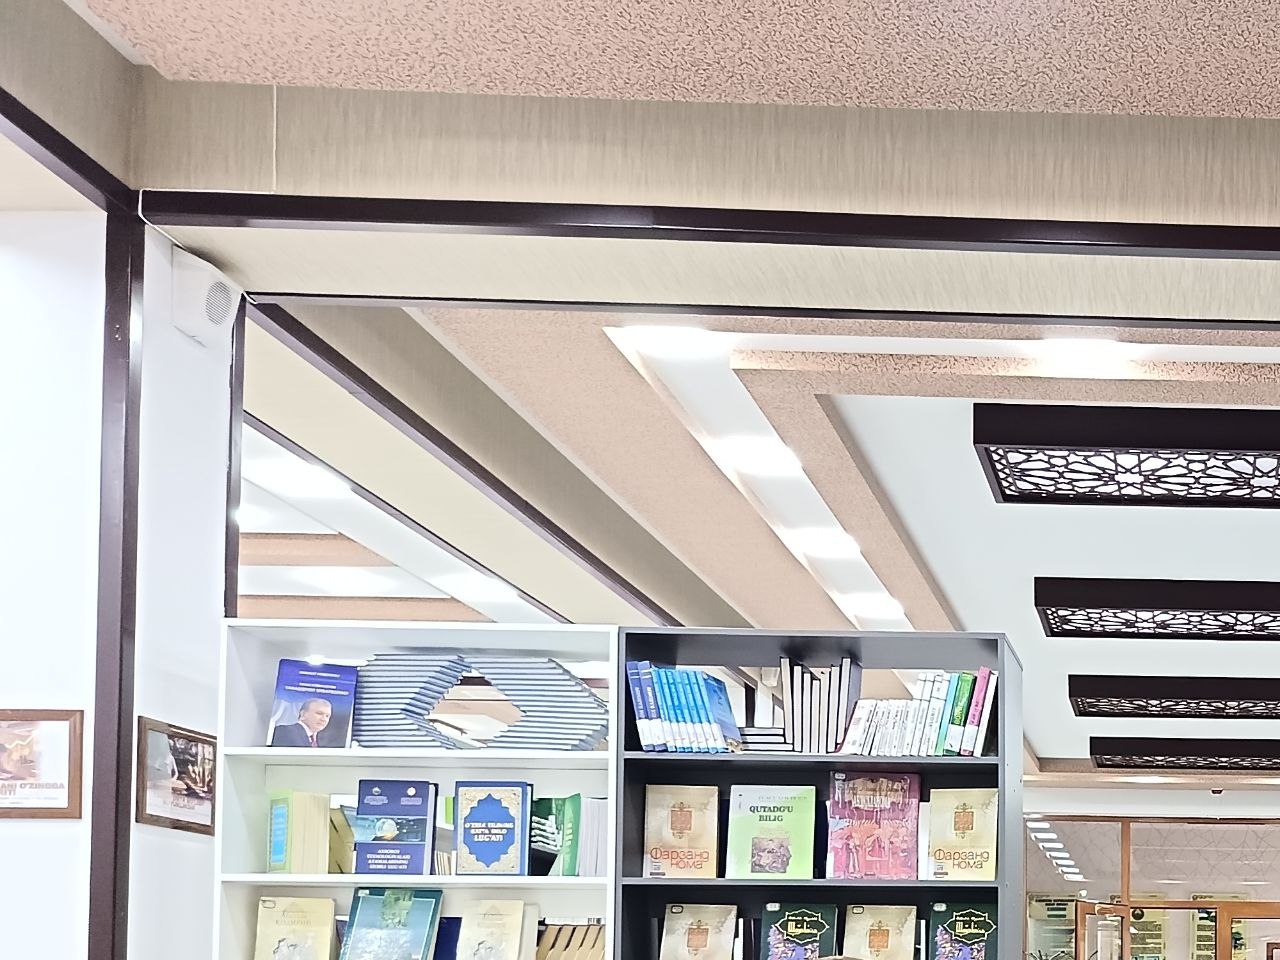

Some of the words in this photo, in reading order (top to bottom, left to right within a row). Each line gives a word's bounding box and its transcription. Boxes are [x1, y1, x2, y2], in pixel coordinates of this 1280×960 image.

[758, 814, 783, 822] BILIG
[934, 849, 989, 863] Фарзанд
[952, 859, 984, 870] нома
